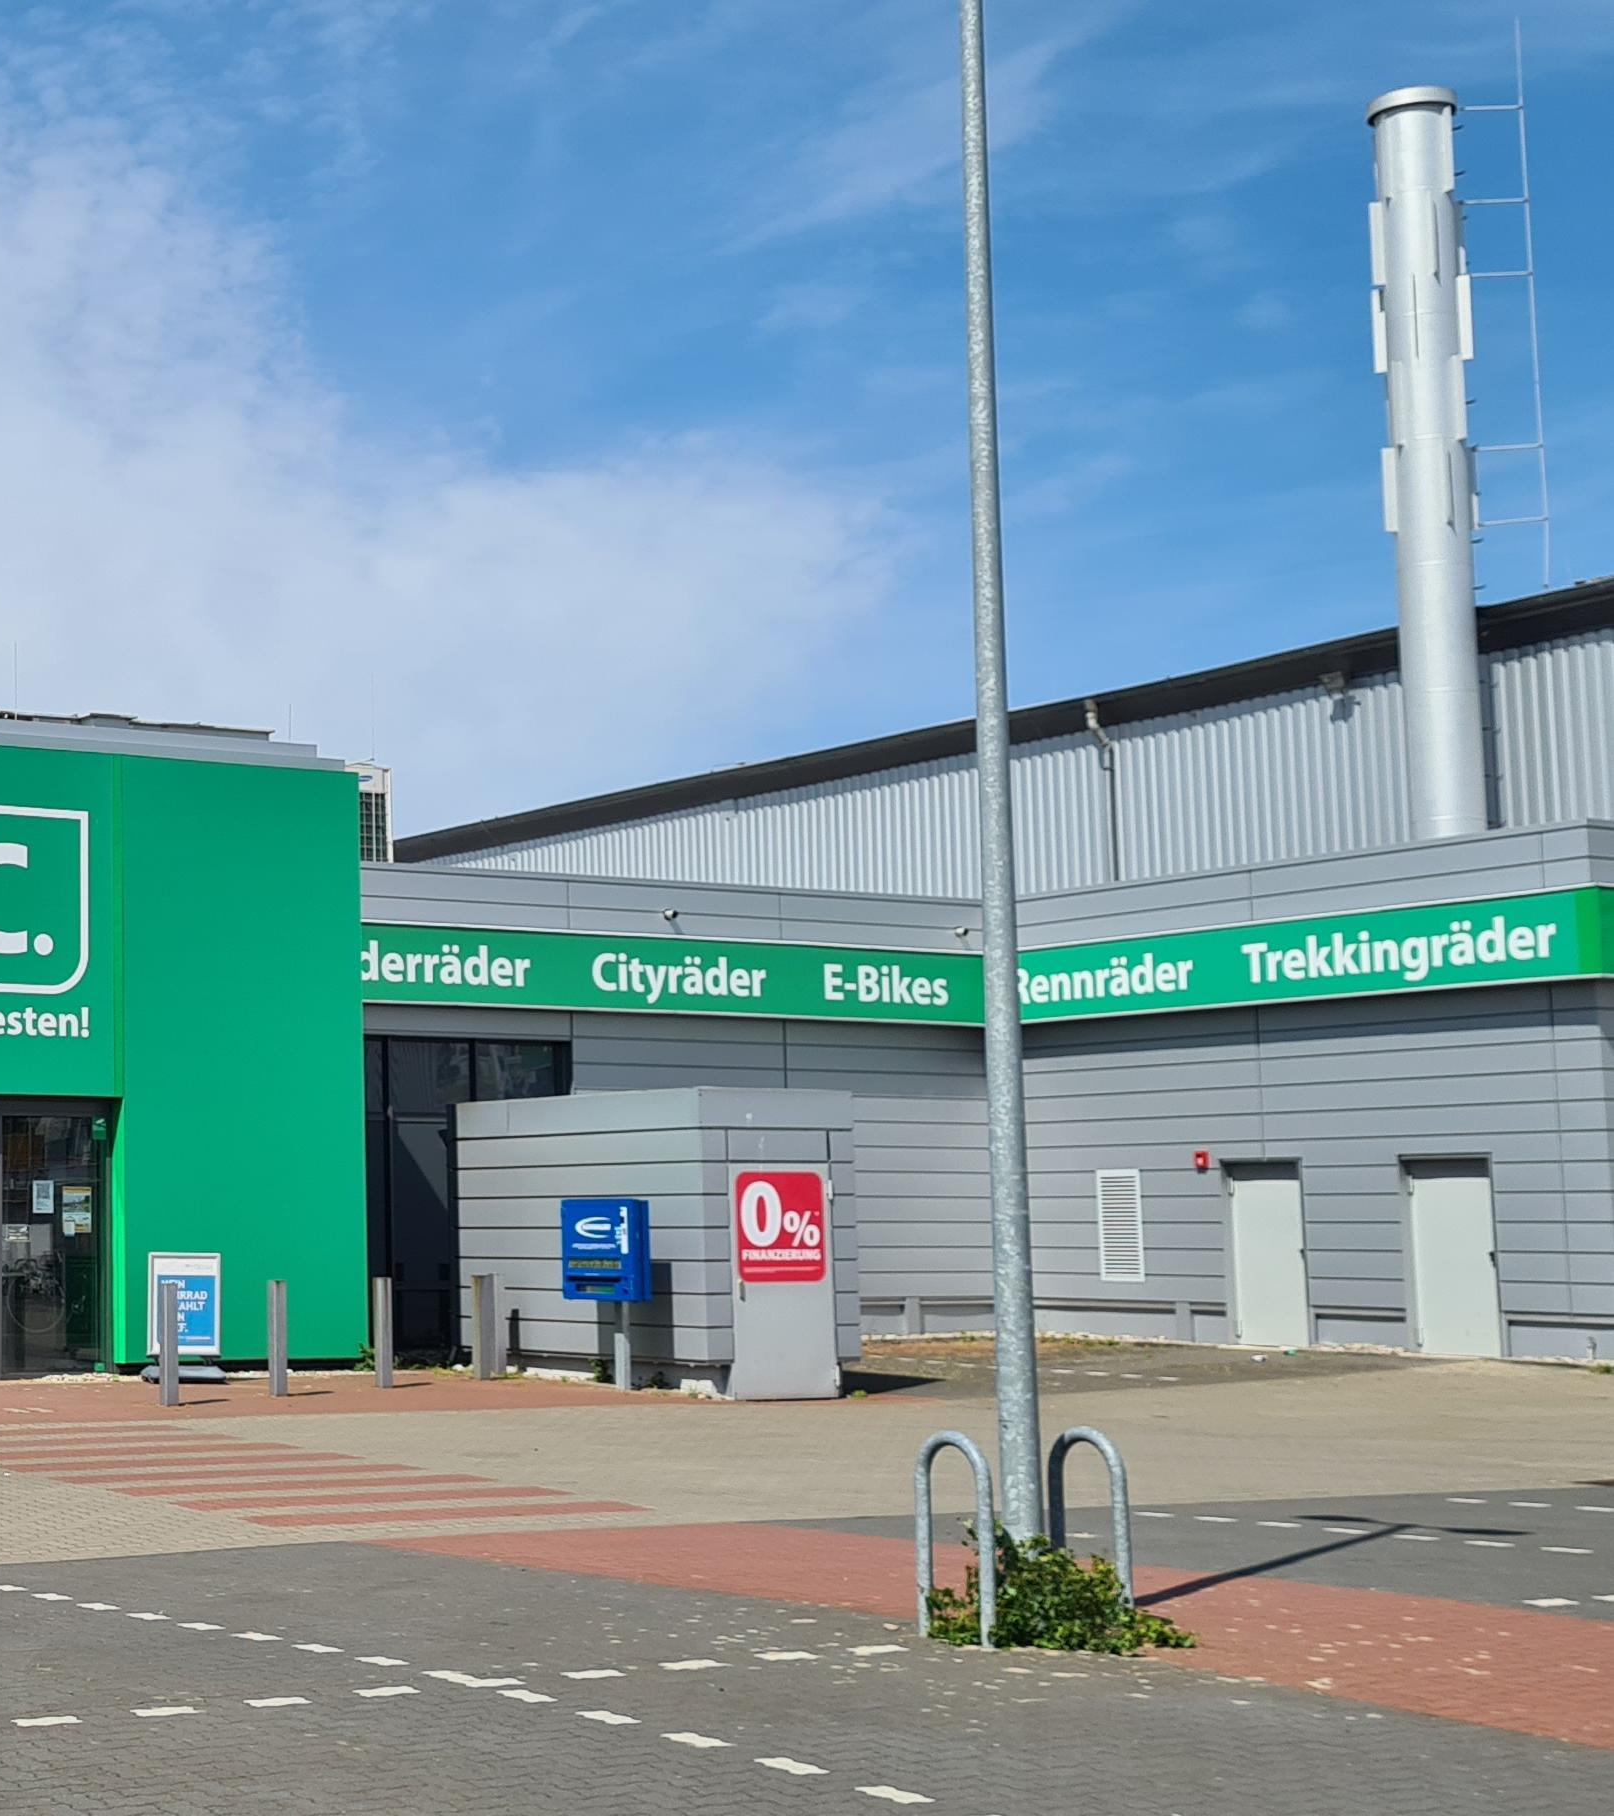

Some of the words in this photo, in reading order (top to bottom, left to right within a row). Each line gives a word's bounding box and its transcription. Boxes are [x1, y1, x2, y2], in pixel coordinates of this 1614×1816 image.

[1241, 916, 1557, 982] Trekkingräder
[591, 952, 767, 1004] Cityräder
[823, 963, 949, 1006] E-Bikes
